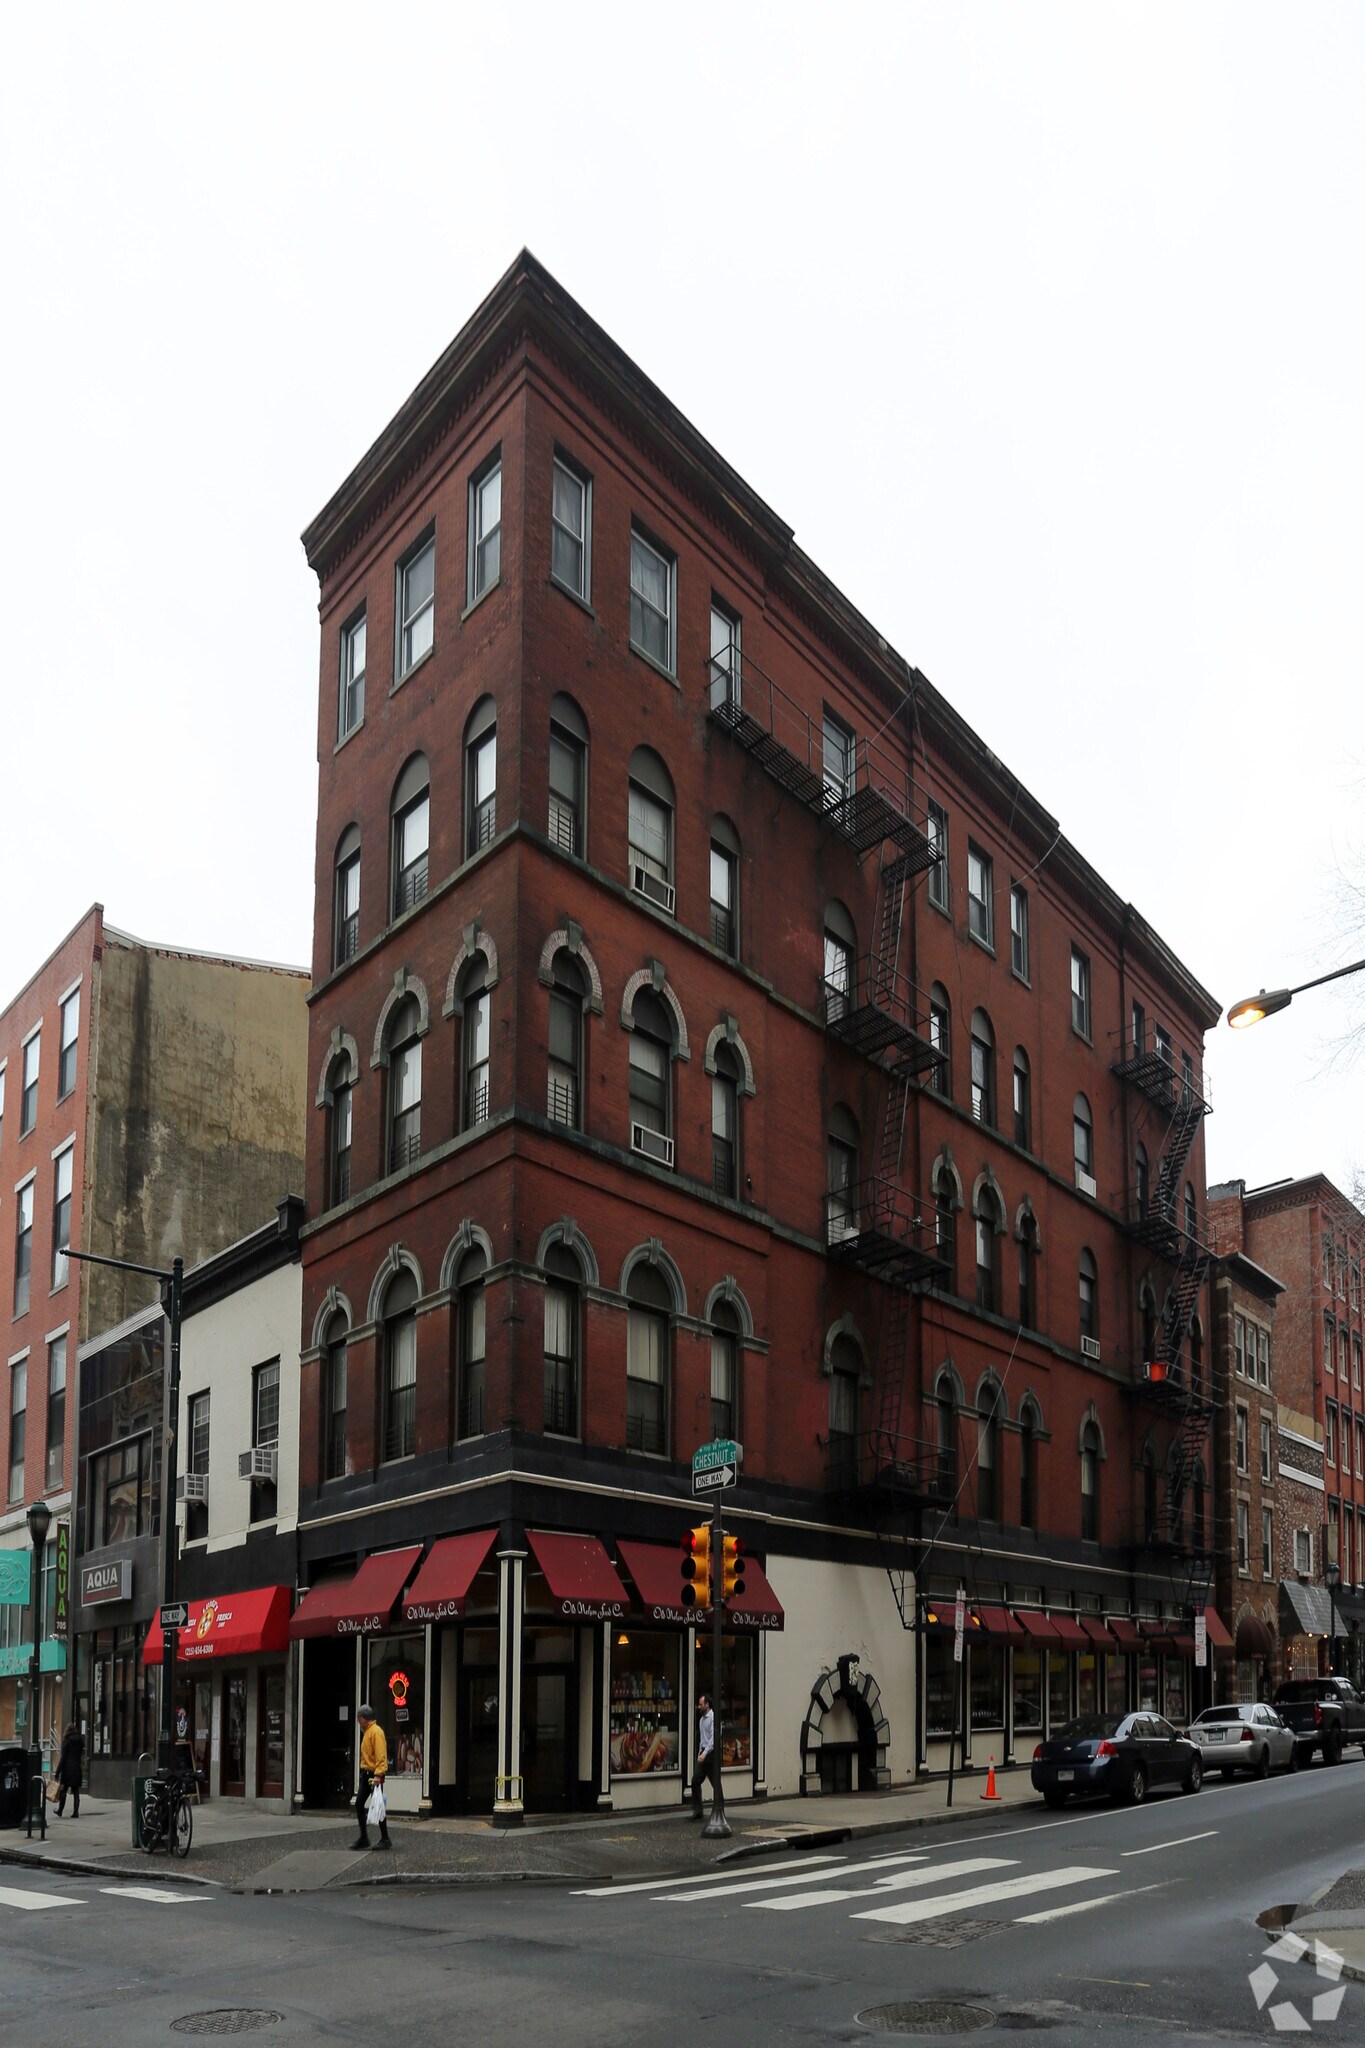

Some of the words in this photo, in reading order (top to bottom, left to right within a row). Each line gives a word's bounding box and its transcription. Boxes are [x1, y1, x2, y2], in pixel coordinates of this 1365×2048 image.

[694, 1449, 729, 1469] CHESTNUT
[730, 1450, 737, 1461] ST
[697, 1475, 709, 1487] ONE
[710, 1472, 723, 1483] WAY
[57, 1529, 68, 1617] AQUA
[86, 1567, 118, 1590] AQUA
[407, 1606, 418, 1620] Old
[562, 1600, 576, 1615] Old
[653, 1606, 665, 1620] Old
[163, 1611, 171, 1622] ONE
[171, 1610, 180, 1621] WAY
